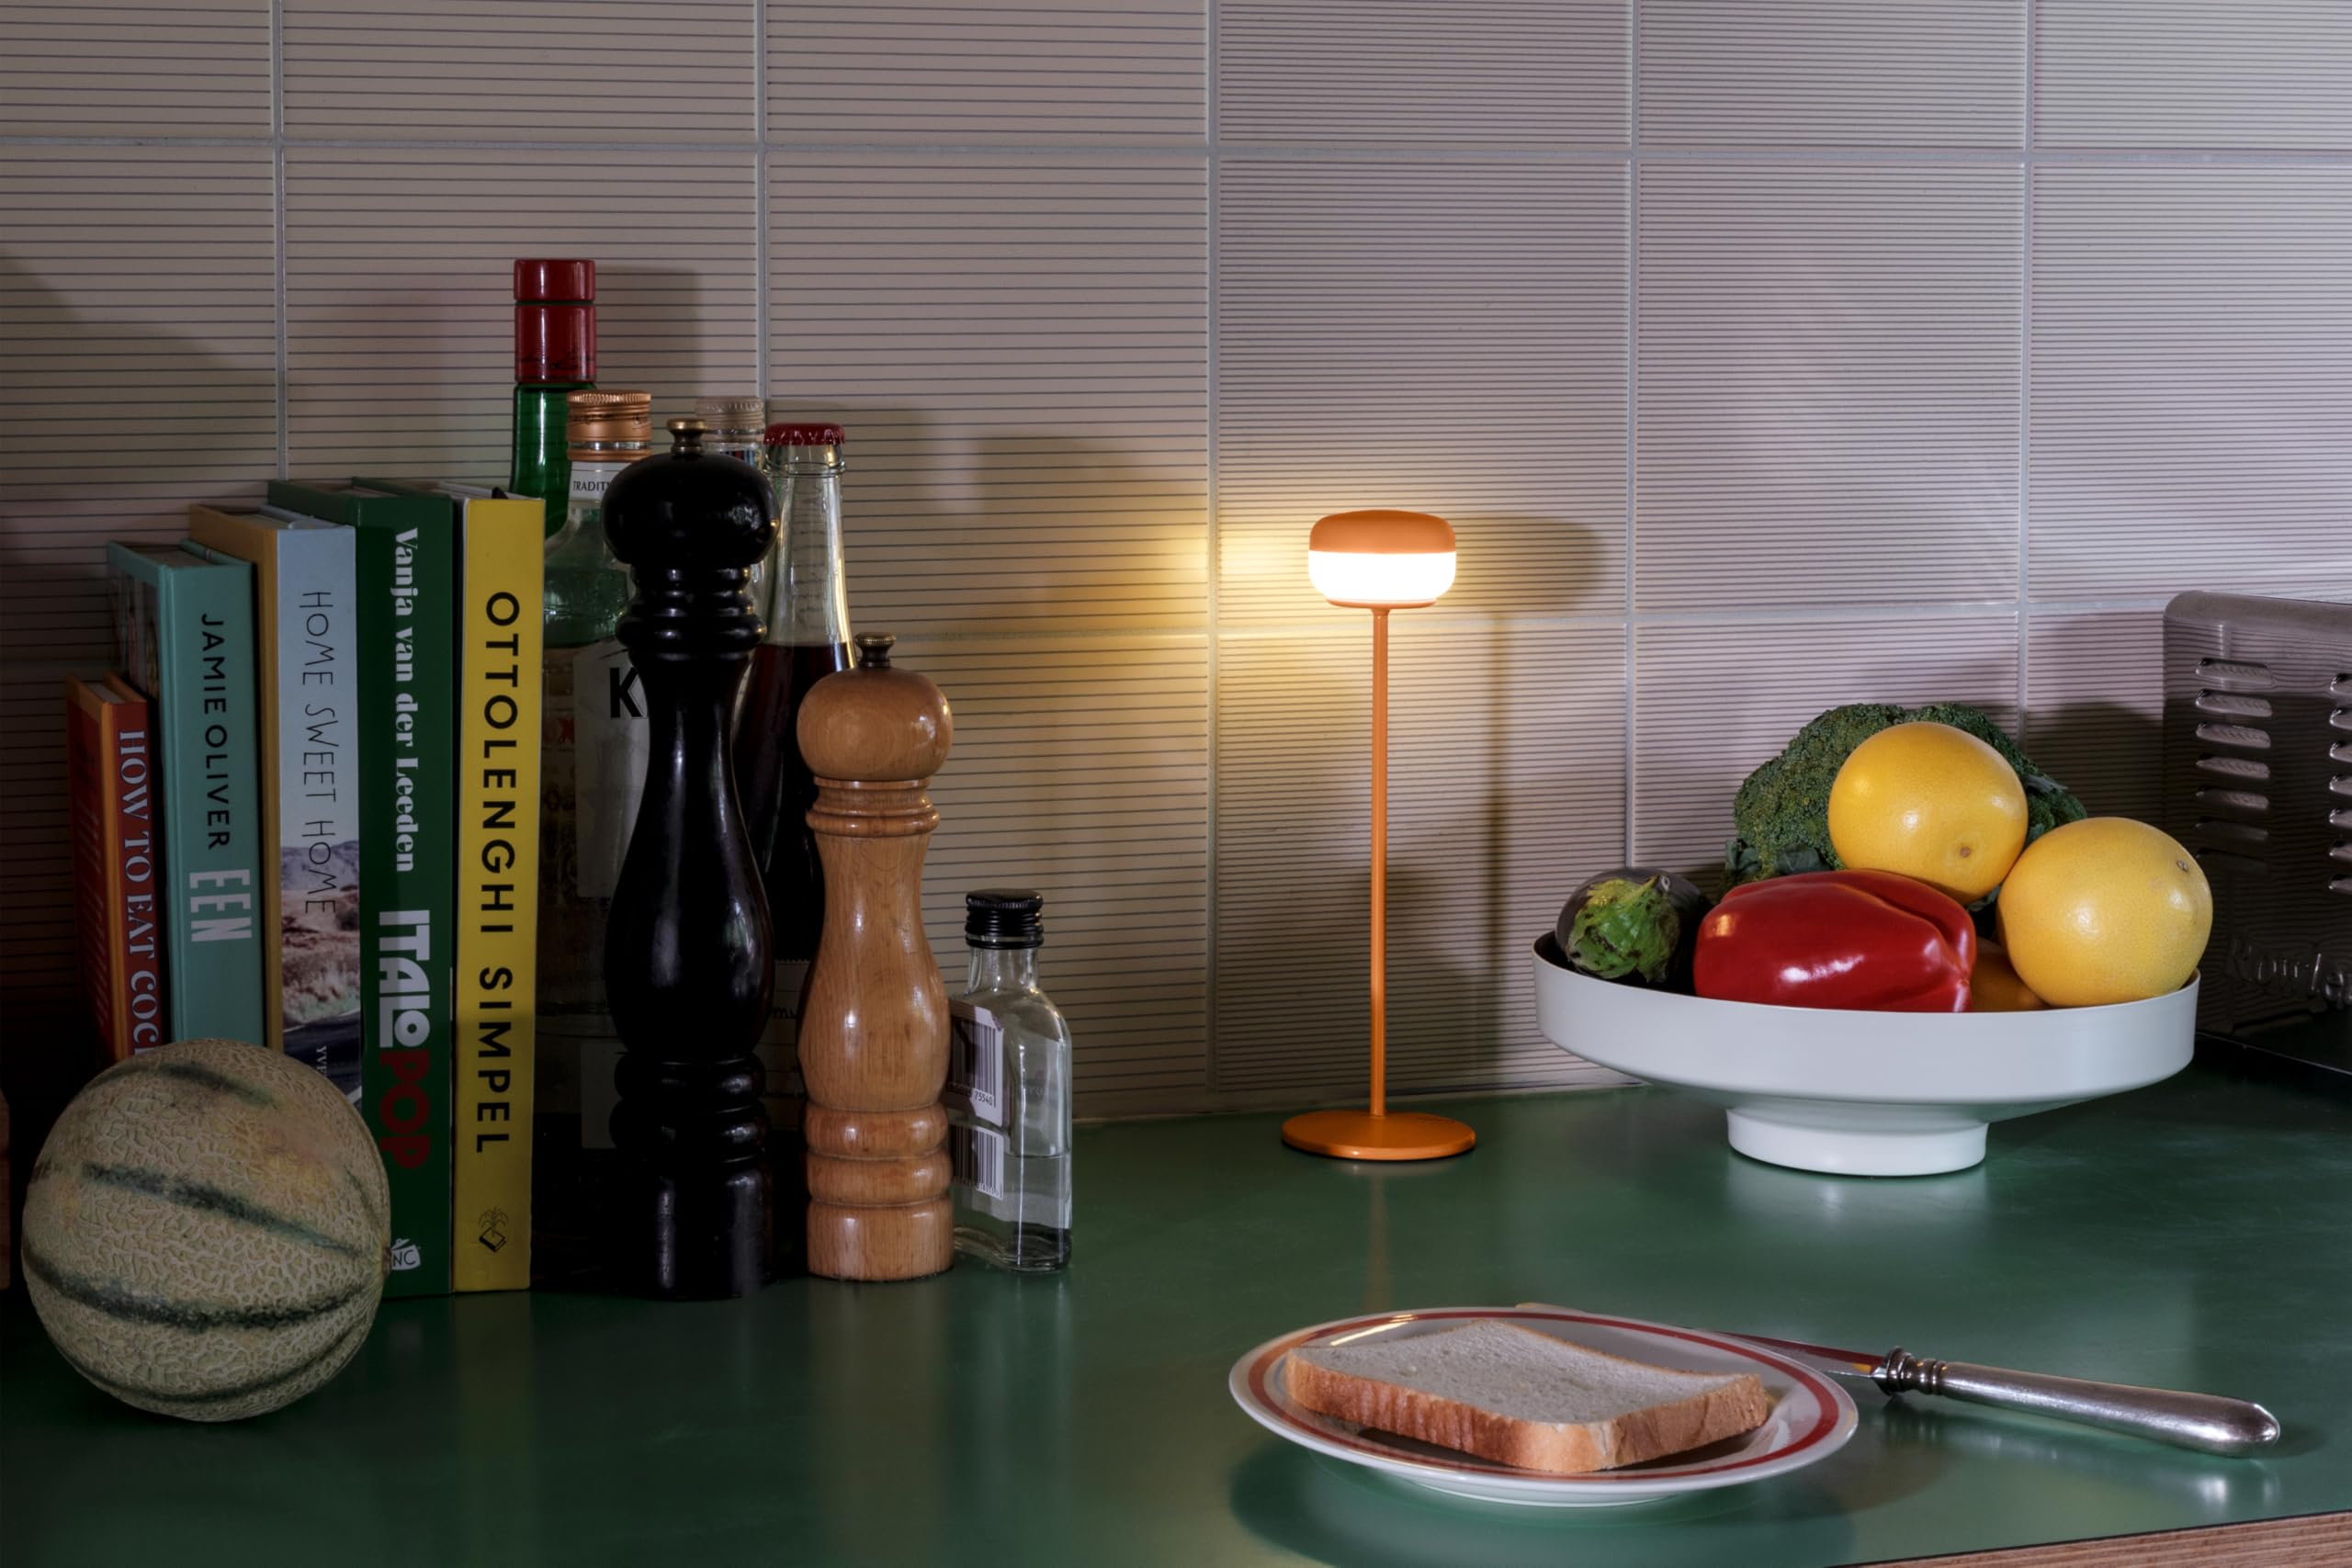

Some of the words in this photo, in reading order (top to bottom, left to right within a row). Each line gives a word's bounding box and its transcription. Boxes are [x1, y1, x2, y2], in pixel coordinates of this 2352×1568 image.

[390, 527, 418, 616] Vanja
[201, 613, 227, 715] JAMIE
[299, 591, 334, 685] HOME
[396, 626, 418, 682] van
[304, 704, 339, 802] SWEET
[396, 693, 418, 748] der
[481, 592, 520, 933] OTTOLENGHI
[119, 730, 147, 820] HOW
[205, 724, 231, 850] OLIVER
[396, 757, 418, 872] Leeden
[124, 830, 152, 882] TO
[301, 820, 336, 914] HOME
[127, 894, 158, 959] EAT
[188, 869, 253, 942] EEN
[379, 909, 431, 1048] ITALO
[477, 967, 514, 1154] SIMPEL
[379, 1050, 431, 1169] POP
